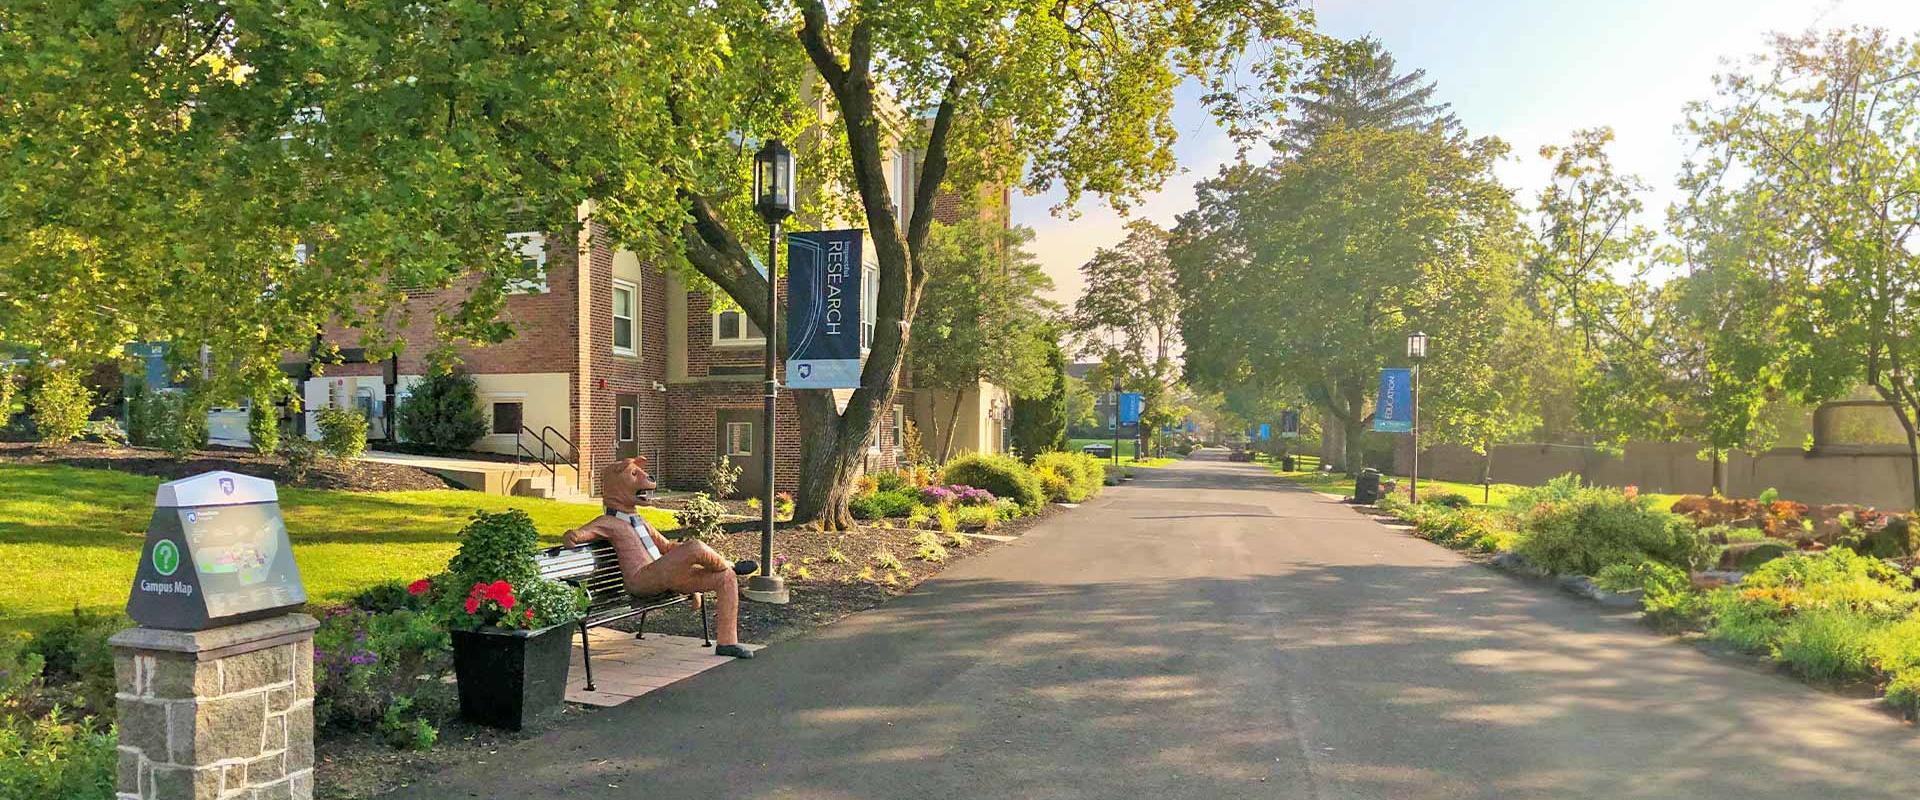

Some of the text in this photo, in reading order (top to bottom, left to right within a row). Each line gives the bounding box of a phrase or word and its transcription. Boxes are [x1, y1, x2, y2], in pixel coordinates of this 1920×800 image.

[826, 241, 842, 334] RESEARCH
[1385, 376, 1395, 419] EDUCATION
[141, 580, 192, 596] Campus Map
